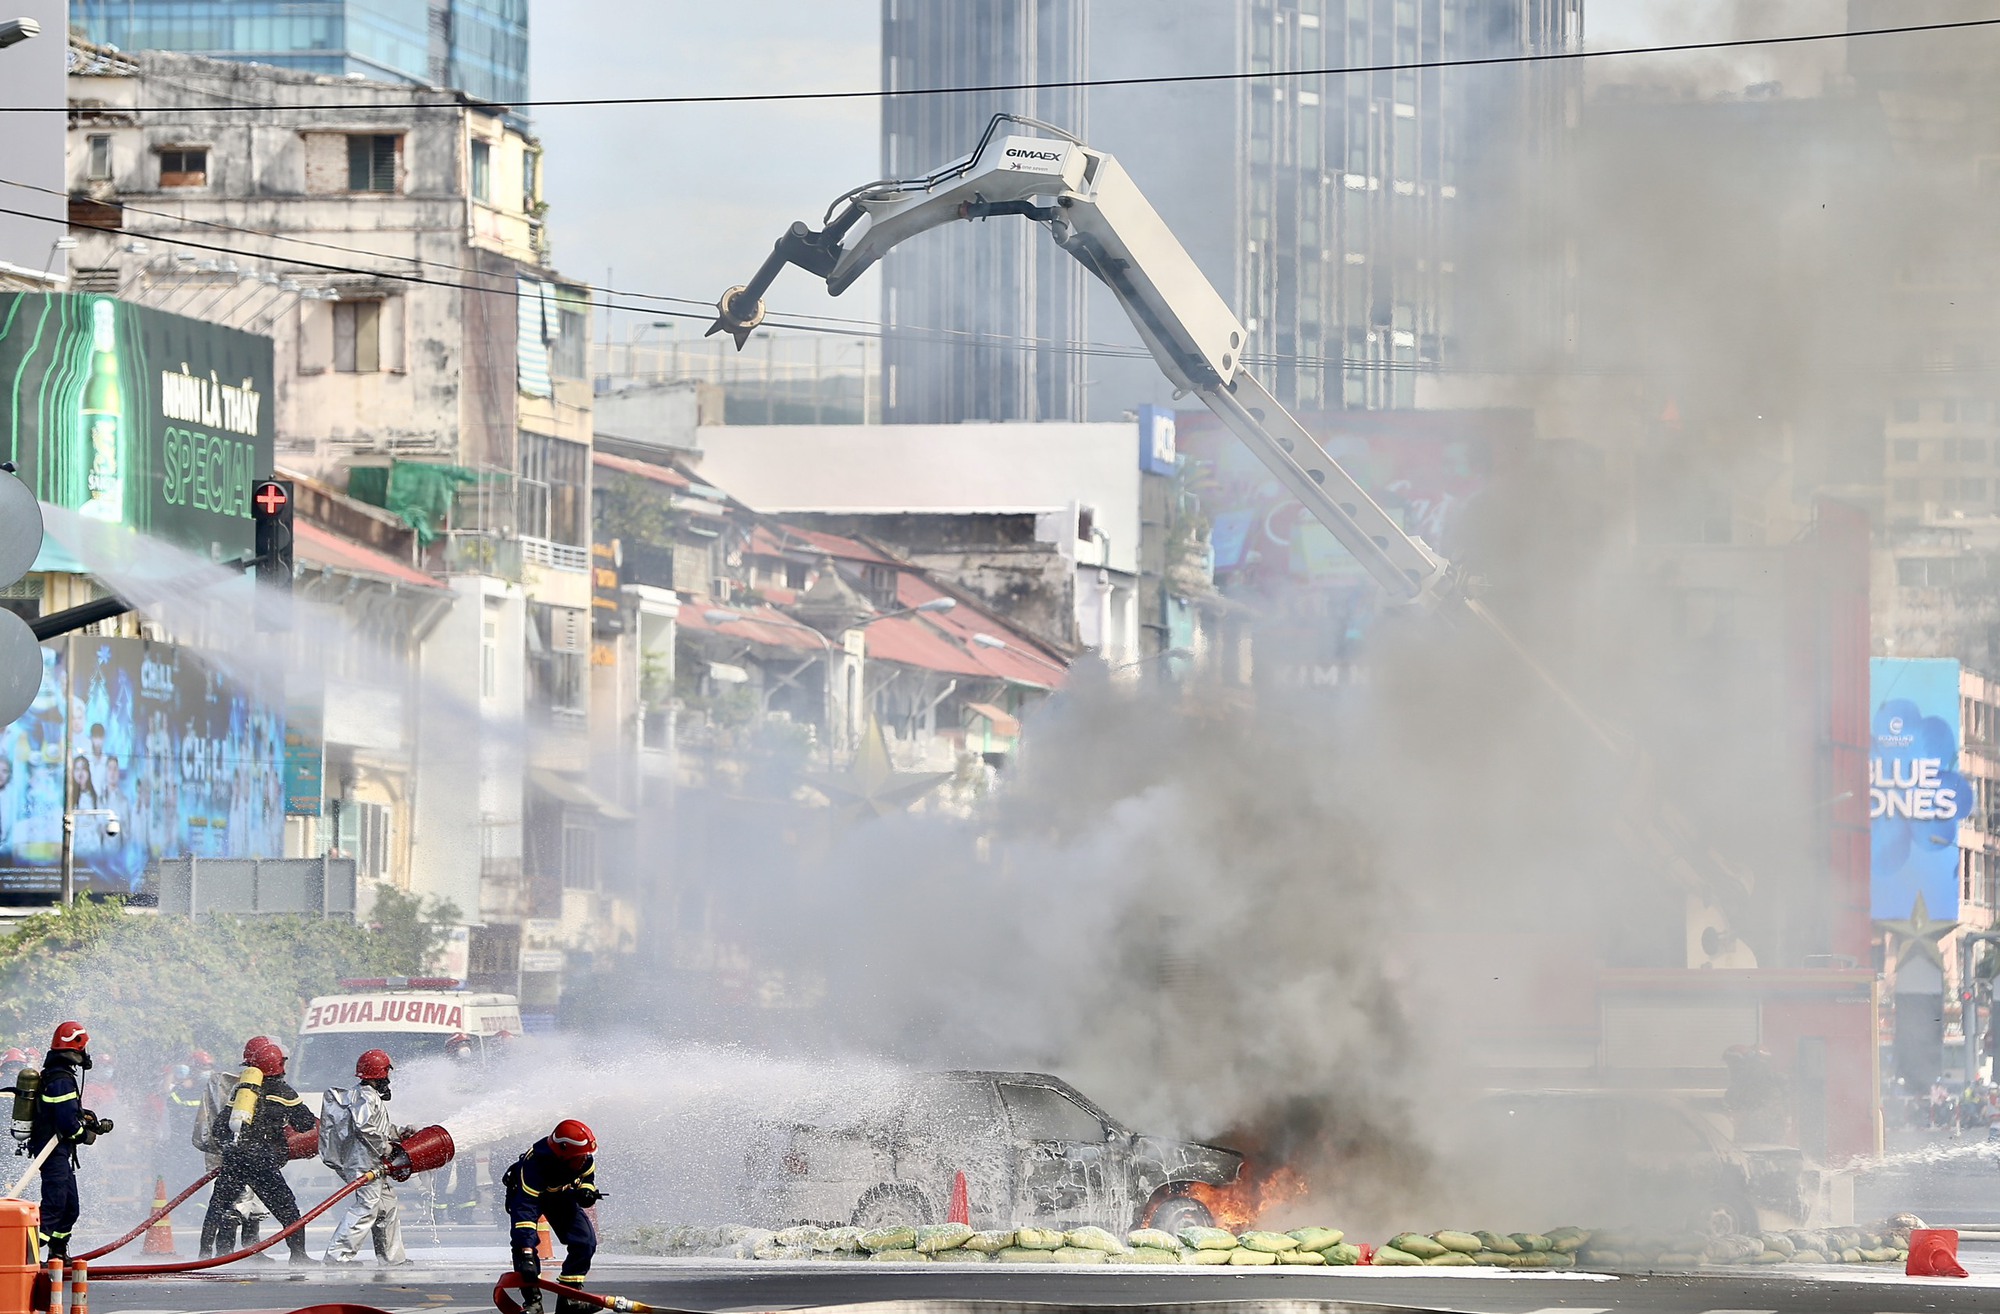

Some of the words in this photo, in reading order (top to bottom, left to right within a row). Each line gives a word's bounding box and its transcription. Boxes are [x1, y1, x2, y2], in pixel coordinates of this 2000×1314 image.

[1005, 148, 1062, 162] GIMAEX
[201, 369, 223, 429] LÀ
[1869, 758, 1941, 789] LUE
